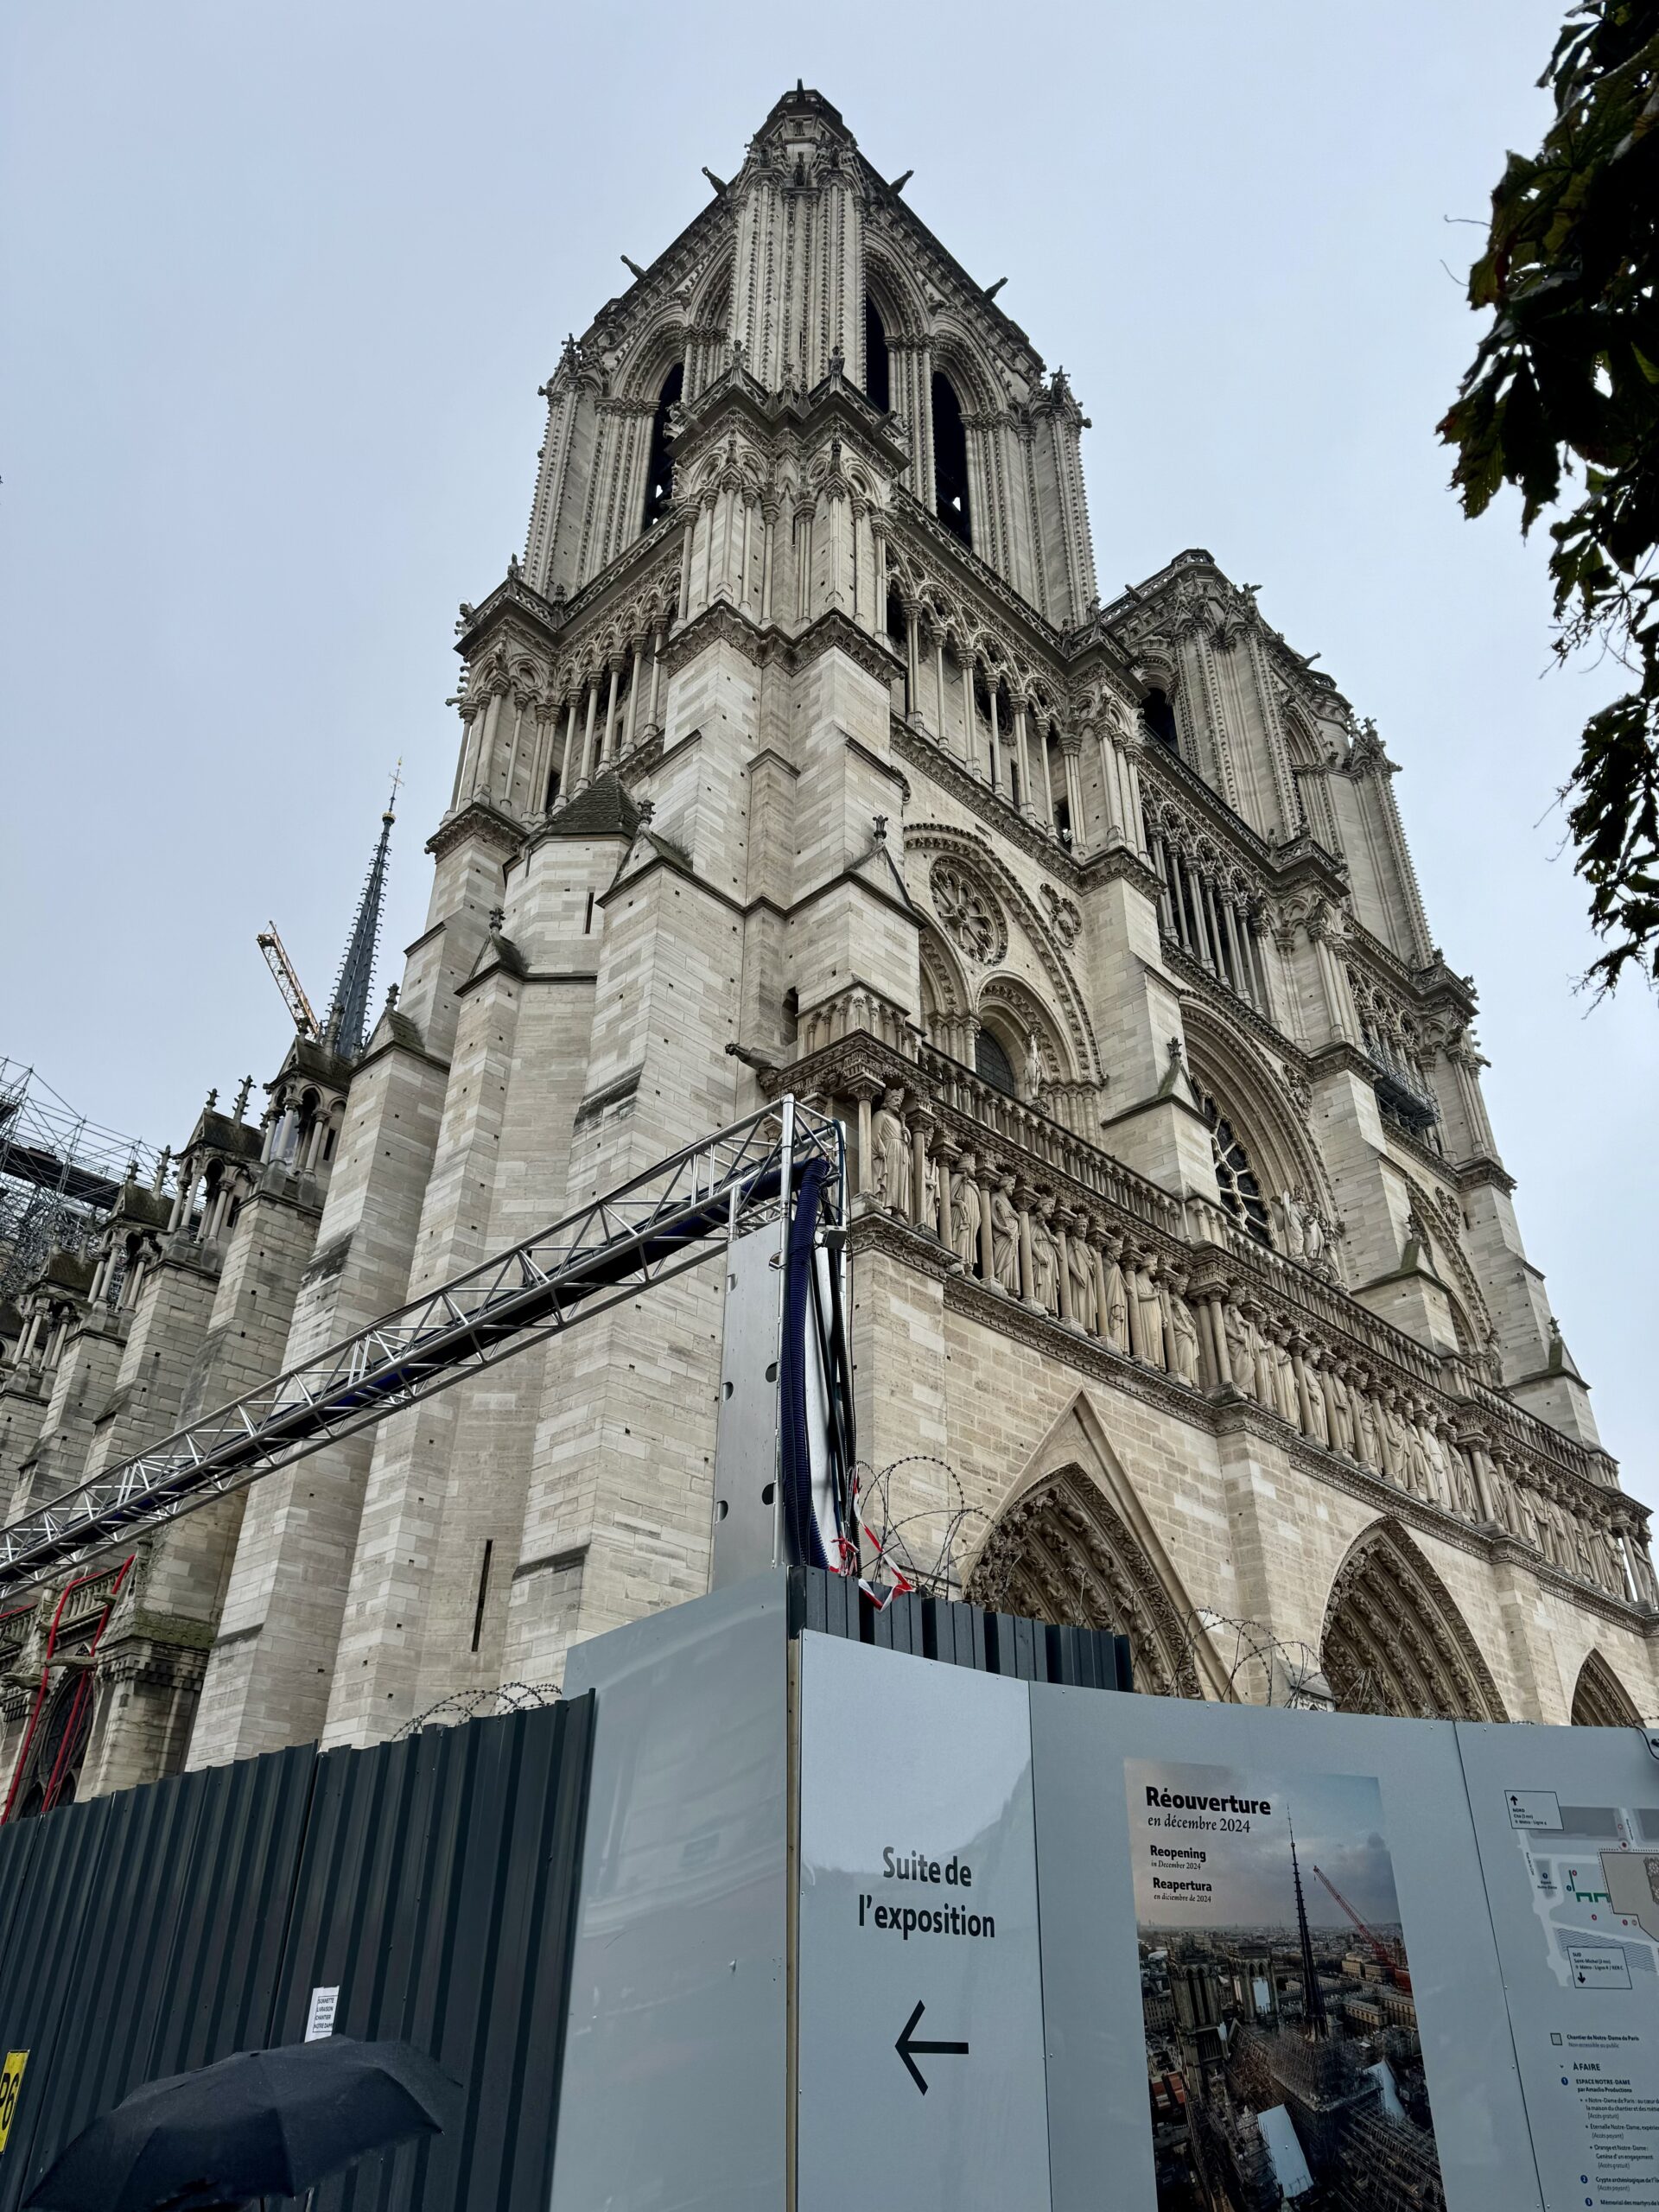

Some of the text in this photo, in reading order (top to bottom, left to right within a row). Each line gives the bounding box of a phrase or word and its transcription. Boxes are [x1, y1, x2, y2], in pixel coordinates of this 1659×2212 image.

[1146, 1786, 1271, 1815] Réouverture
[1147, 1814, 1251, 1833] en décembre 2024
[1150, 1845, 1206, 1863] Reopening
[882, 1846, 972, 1887] Suite de
[1158, 1860, 1185, 1869] December
[1153, 1877, 1212, 1893] Reapertura
[1161, 1892, 1188, 1902] diciembre
[1573, 2062, 1580, 2070] À
